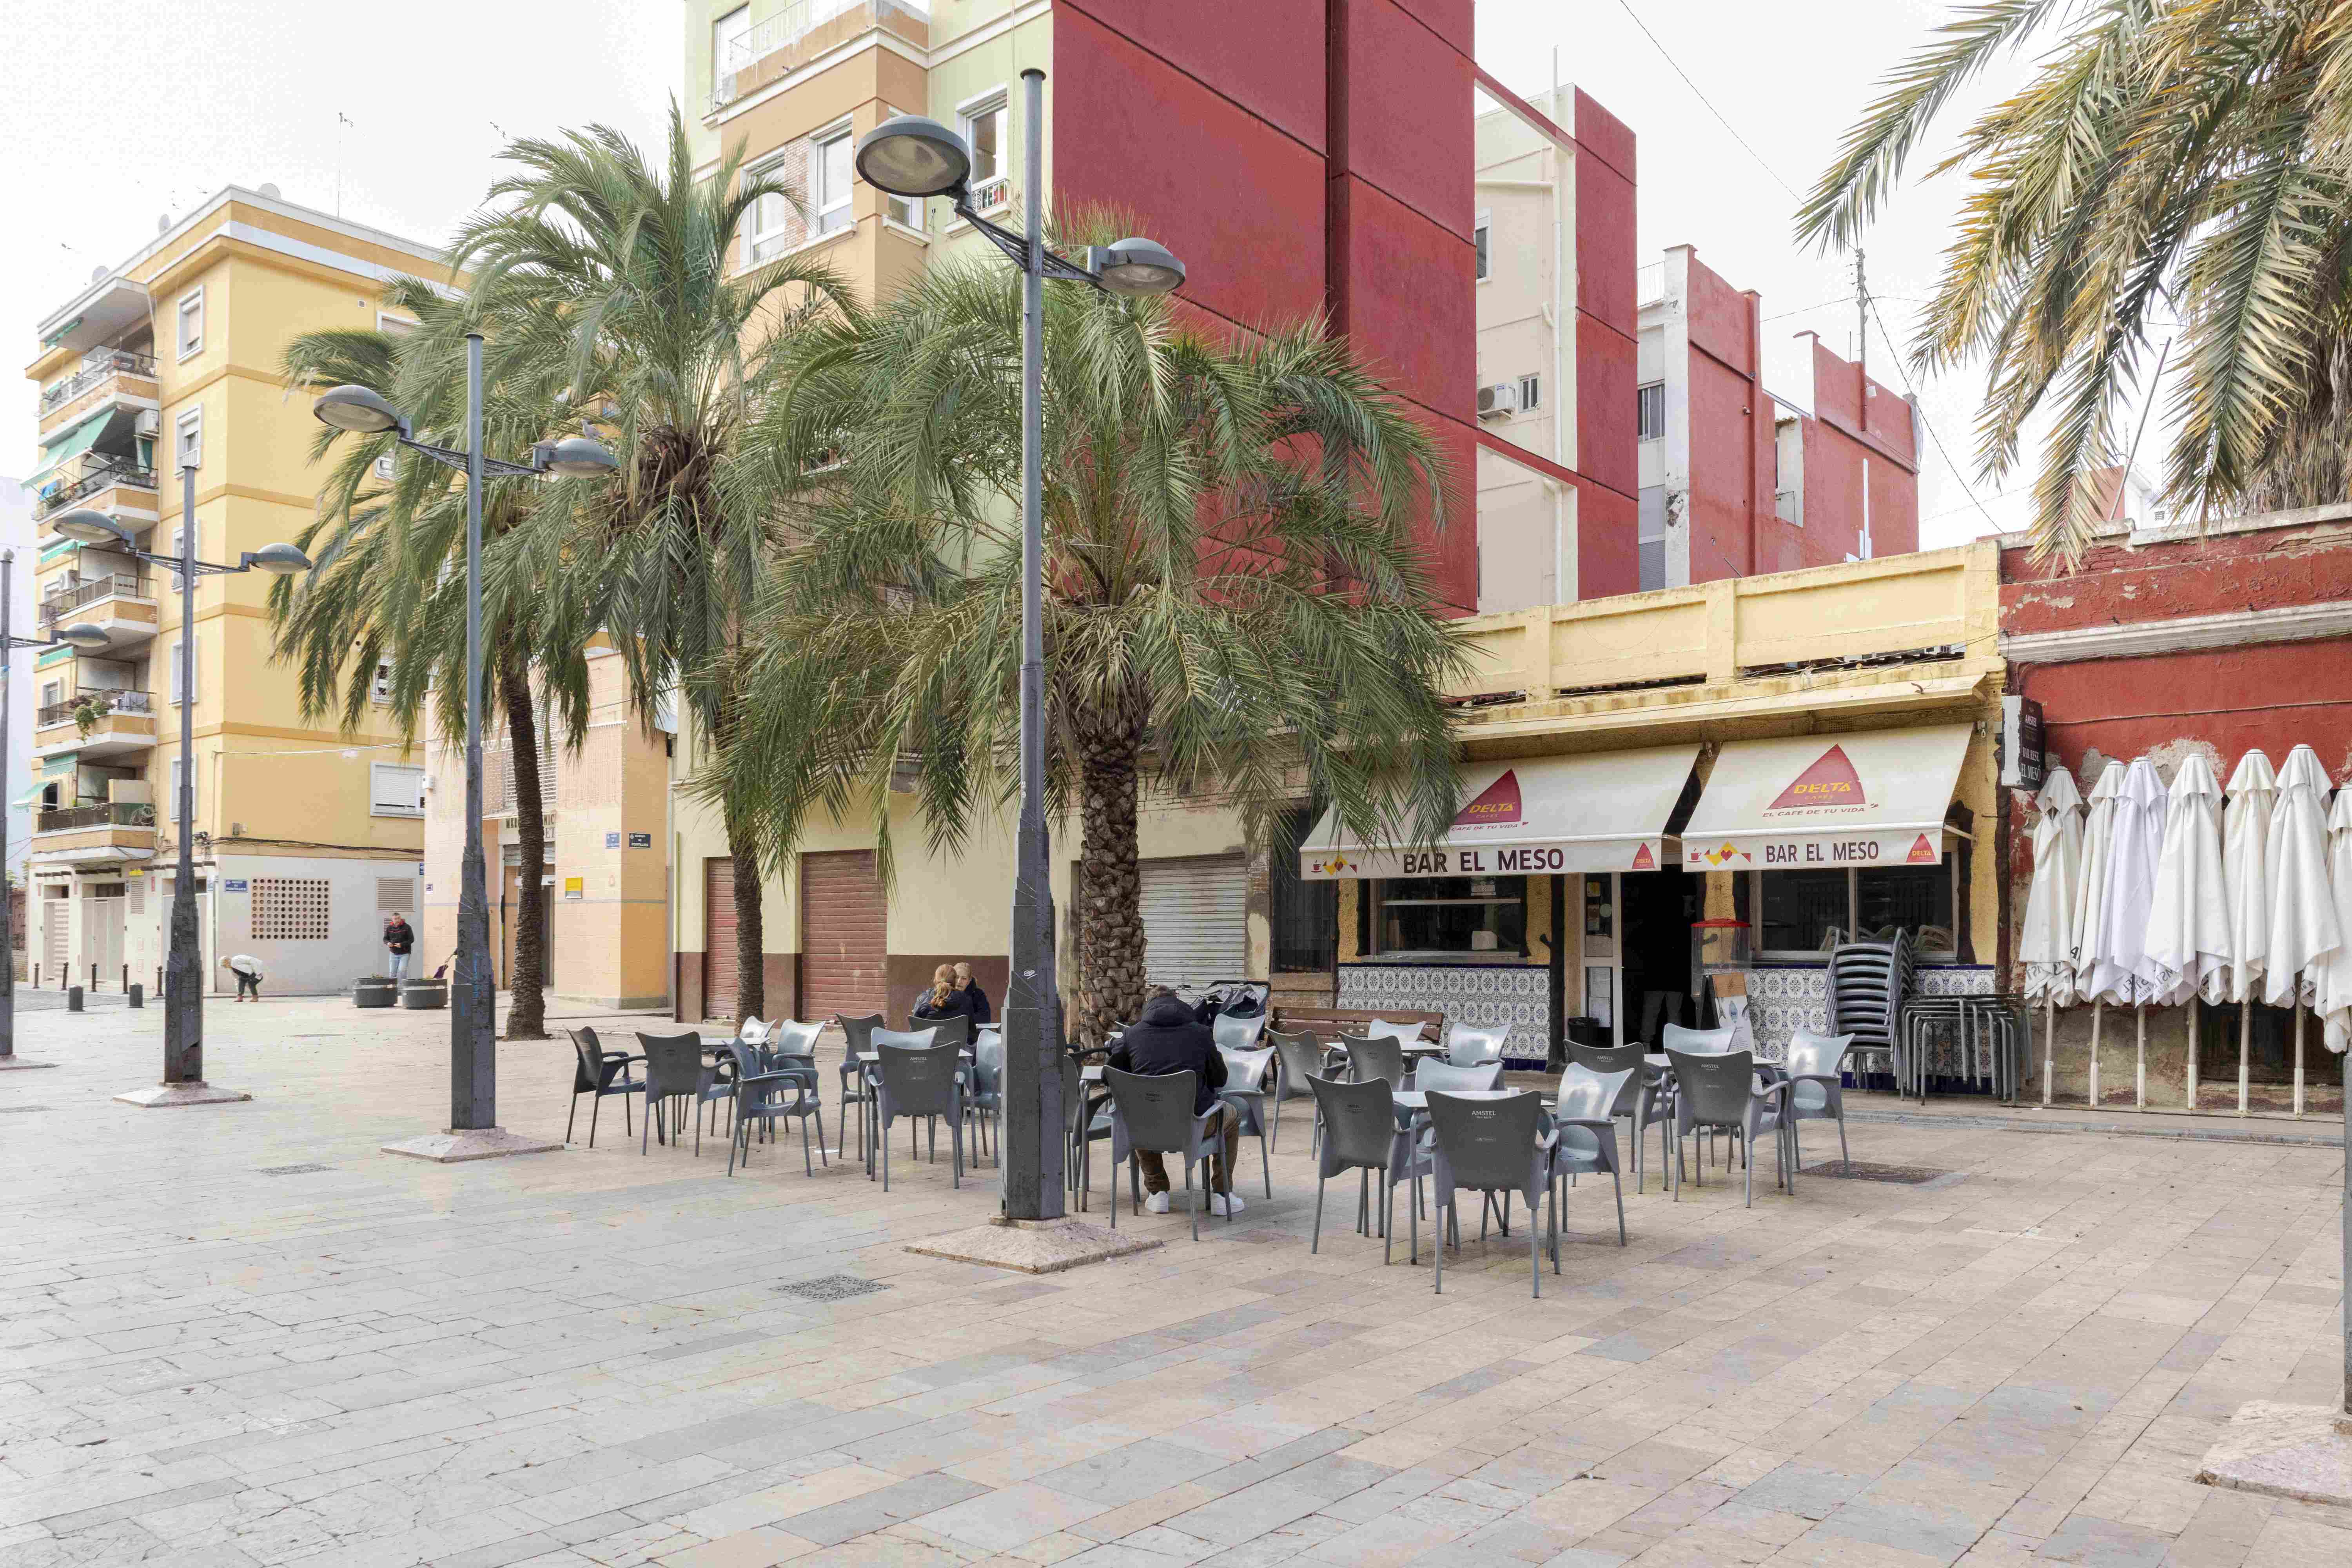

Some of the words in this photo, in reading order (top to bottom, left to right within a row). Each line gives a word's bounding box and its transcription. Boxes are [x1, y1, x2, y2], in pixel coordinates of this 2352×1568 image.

[2025, 715, 2037, 727] AMSTEL
[1794, 781, 1851, 793] DELTA
[1468, 802, 1514, 813] DELTA
[1766, 844, 1797, 863] BAR
[1806, 843, 1824, 862] EL
[1833, 841, 1879, 861] MESO
[1403, 853, 1448, 873] BAR
[1460, 851, 1485, 872] EL
[1498, 848, 1564, 871] MESO
